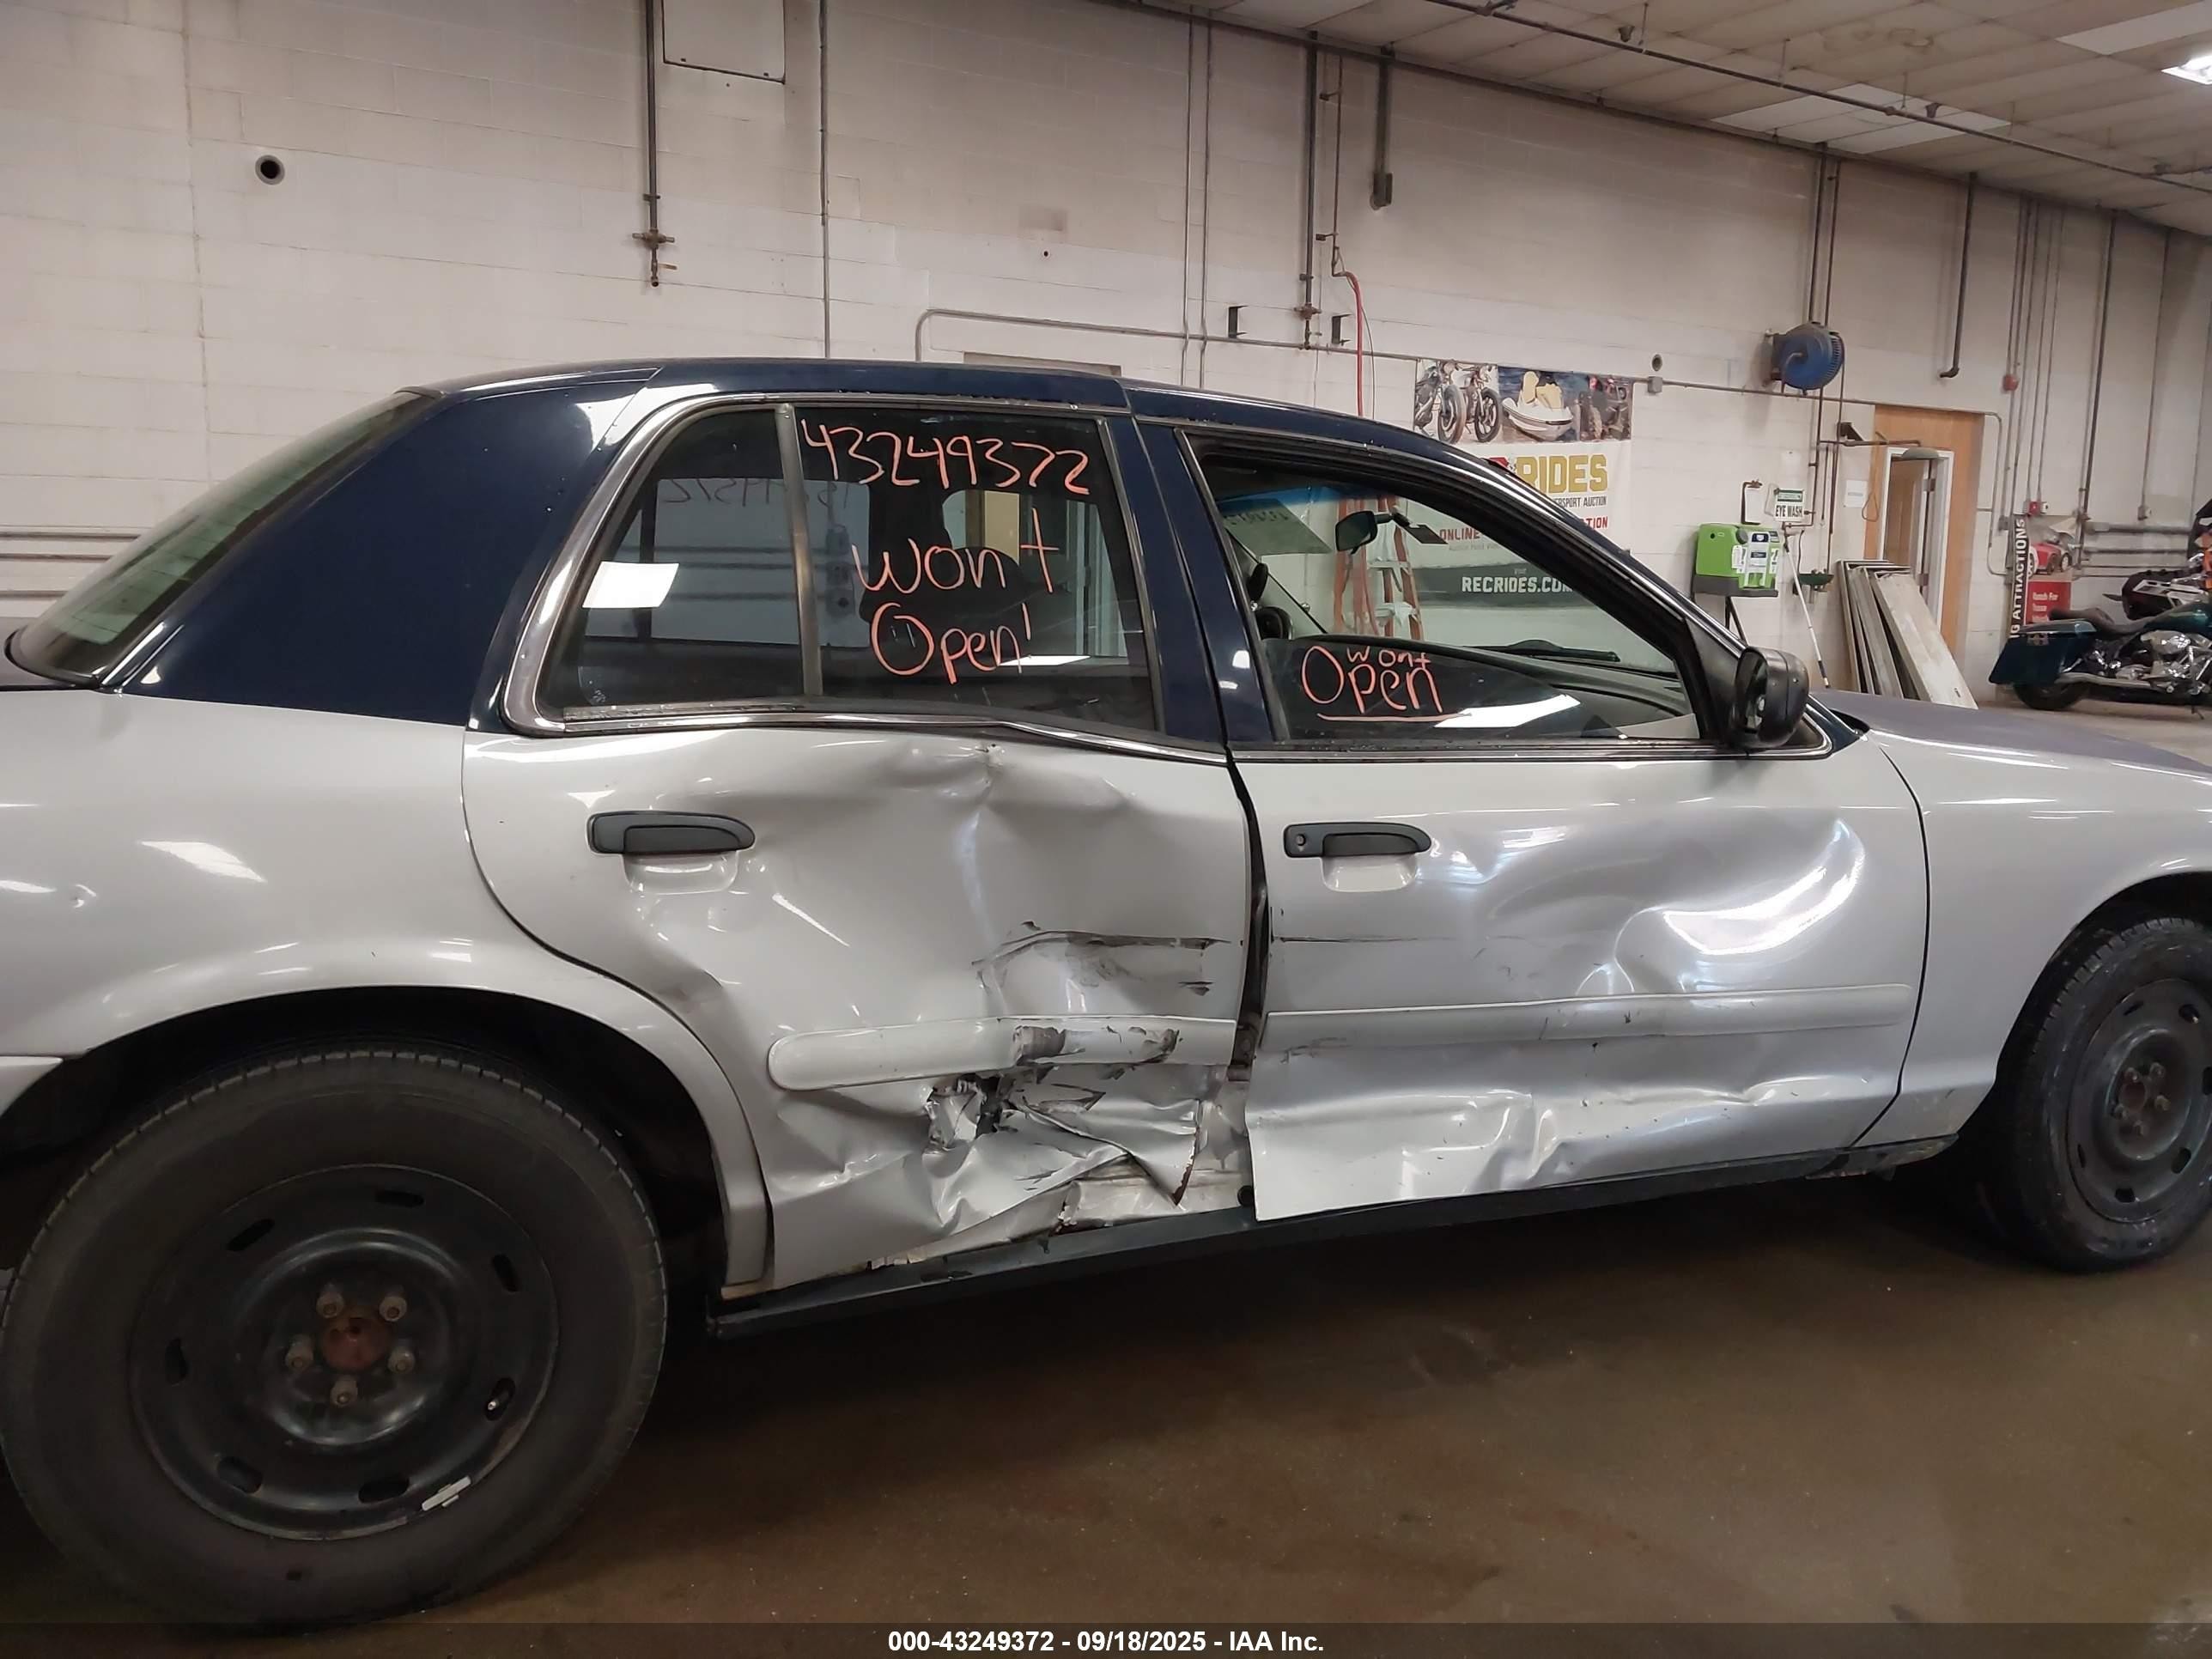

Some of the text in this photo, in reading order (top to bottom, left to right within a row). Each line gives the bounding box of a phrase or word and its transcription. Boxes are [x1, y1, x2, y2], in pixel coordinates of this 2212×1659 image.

[801, 418, 1090, 495] 43249372
[1516, 454, 1607, 494] RIDES
[1583, 496, 1607, 507] AUCTION
[1775, 505, 1787, 517] EYE
[1439, 527, 1481, 541] ONLINE
[1580, 517, 1608, 529] TION
[2012, 519, 2027, 620] ATTRACTIONS
[1301, 645, 1443, 714] Open
